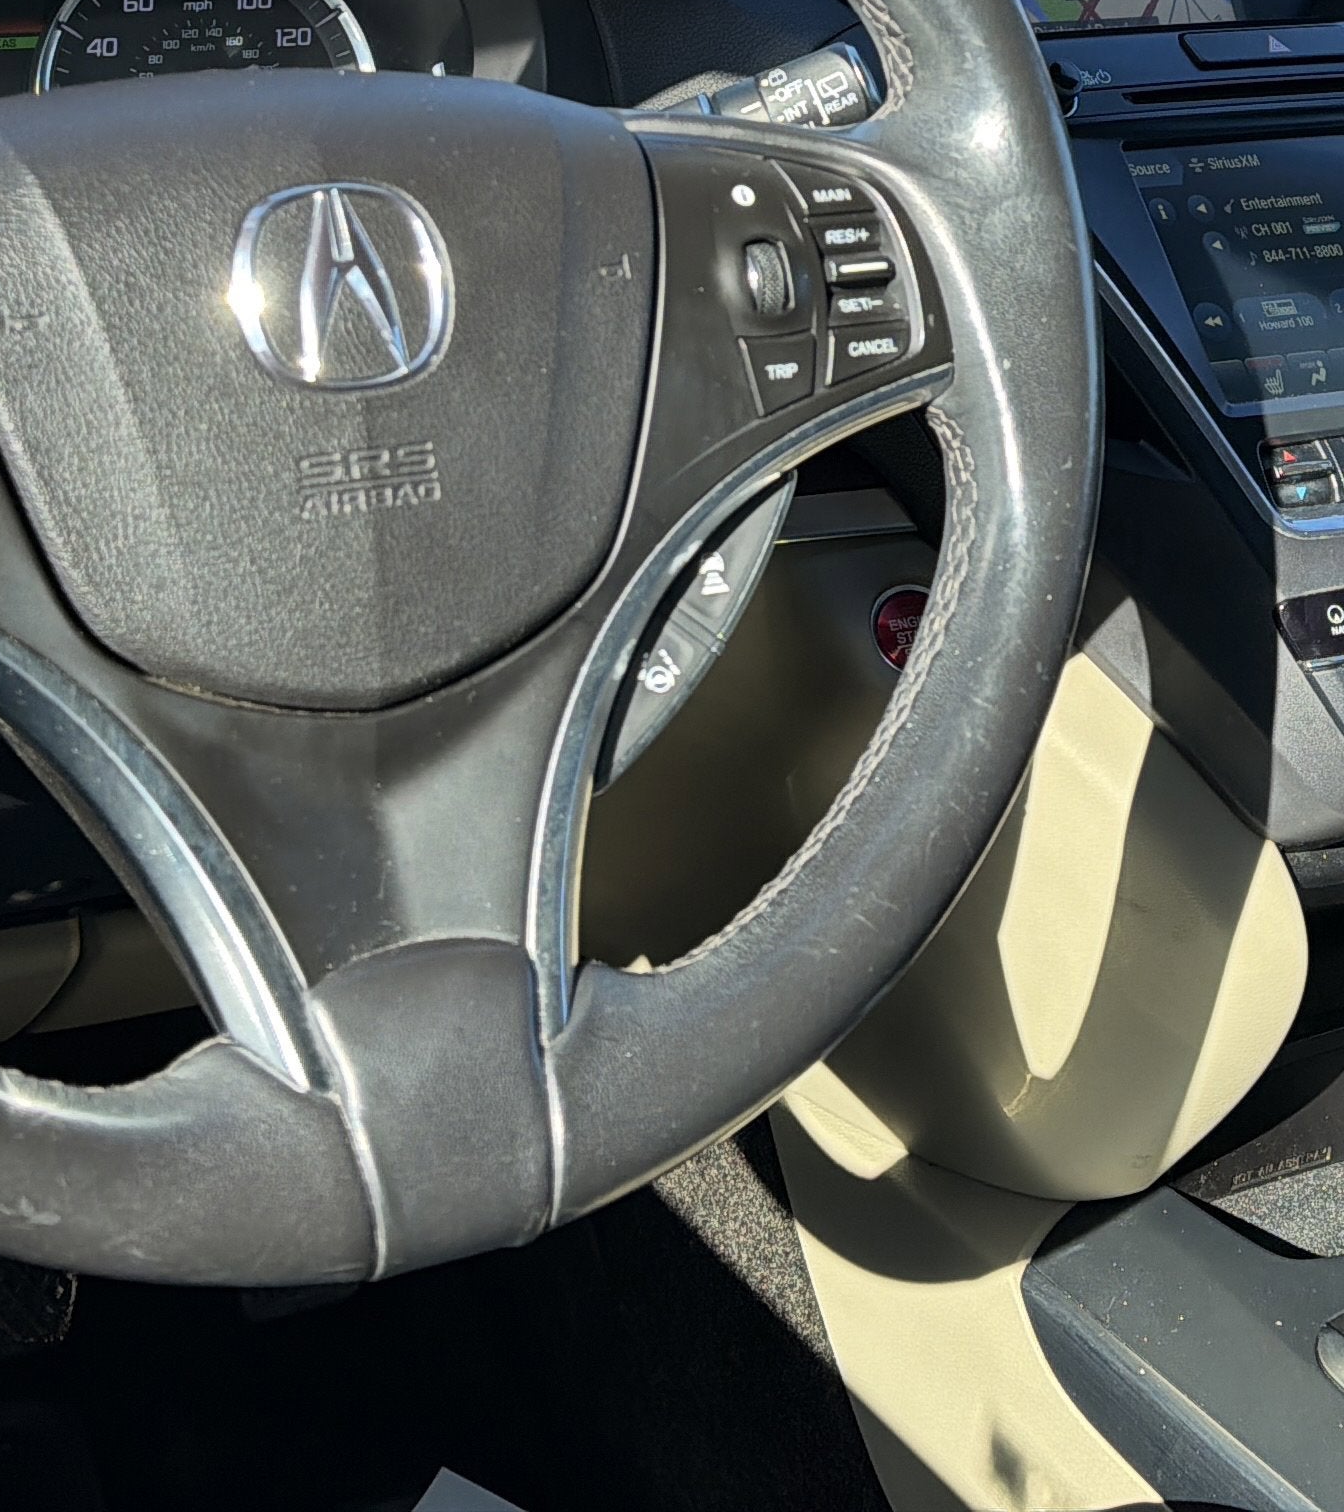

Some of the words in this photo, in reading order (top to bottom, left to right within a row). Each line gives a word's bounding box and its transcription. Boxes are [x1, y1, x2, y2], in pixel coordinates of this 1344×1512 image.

[183, 0, 213, 13] mph
[181, 28, 199, 39] 120
[205, 27, 223, 38] 140
[275, 28, 312, 48] 120
[86, 37, 118, 58] 40
[162, 39, 180, 50] 100
[190, 43, 215, 53] km/h
[225, 36, 243, 47] 160
[148, 54, 163, 65] 80
[774, 78, 803, 102] OFF
[782, 99, 809, 123] INT
[824, 92, 859, 115] REAR
[1128, 161, 1171, 177] Source
[1207, 153, 1261, 171] SiriusXM
[812, 188, 853, 203] MAIN
[1240, 192, 1324, 212] Entertainment
[1251, 223, 1269, 237] CH
[1271, 221, 1293, 235] 001
[1262, 243, 1344, 263] 844-711-8800
[1334, 303, 1343, 314] 2
[1259, 317, 1295, 331] Howard
[1295, 315, 1314, 327] 100
[847, 338, 899, 357] CANCEL
[765, 363, 799, 380] TRIP
[298, 440, 436, 483] SRS
[299, 481, 441, 519] AIRBAG
